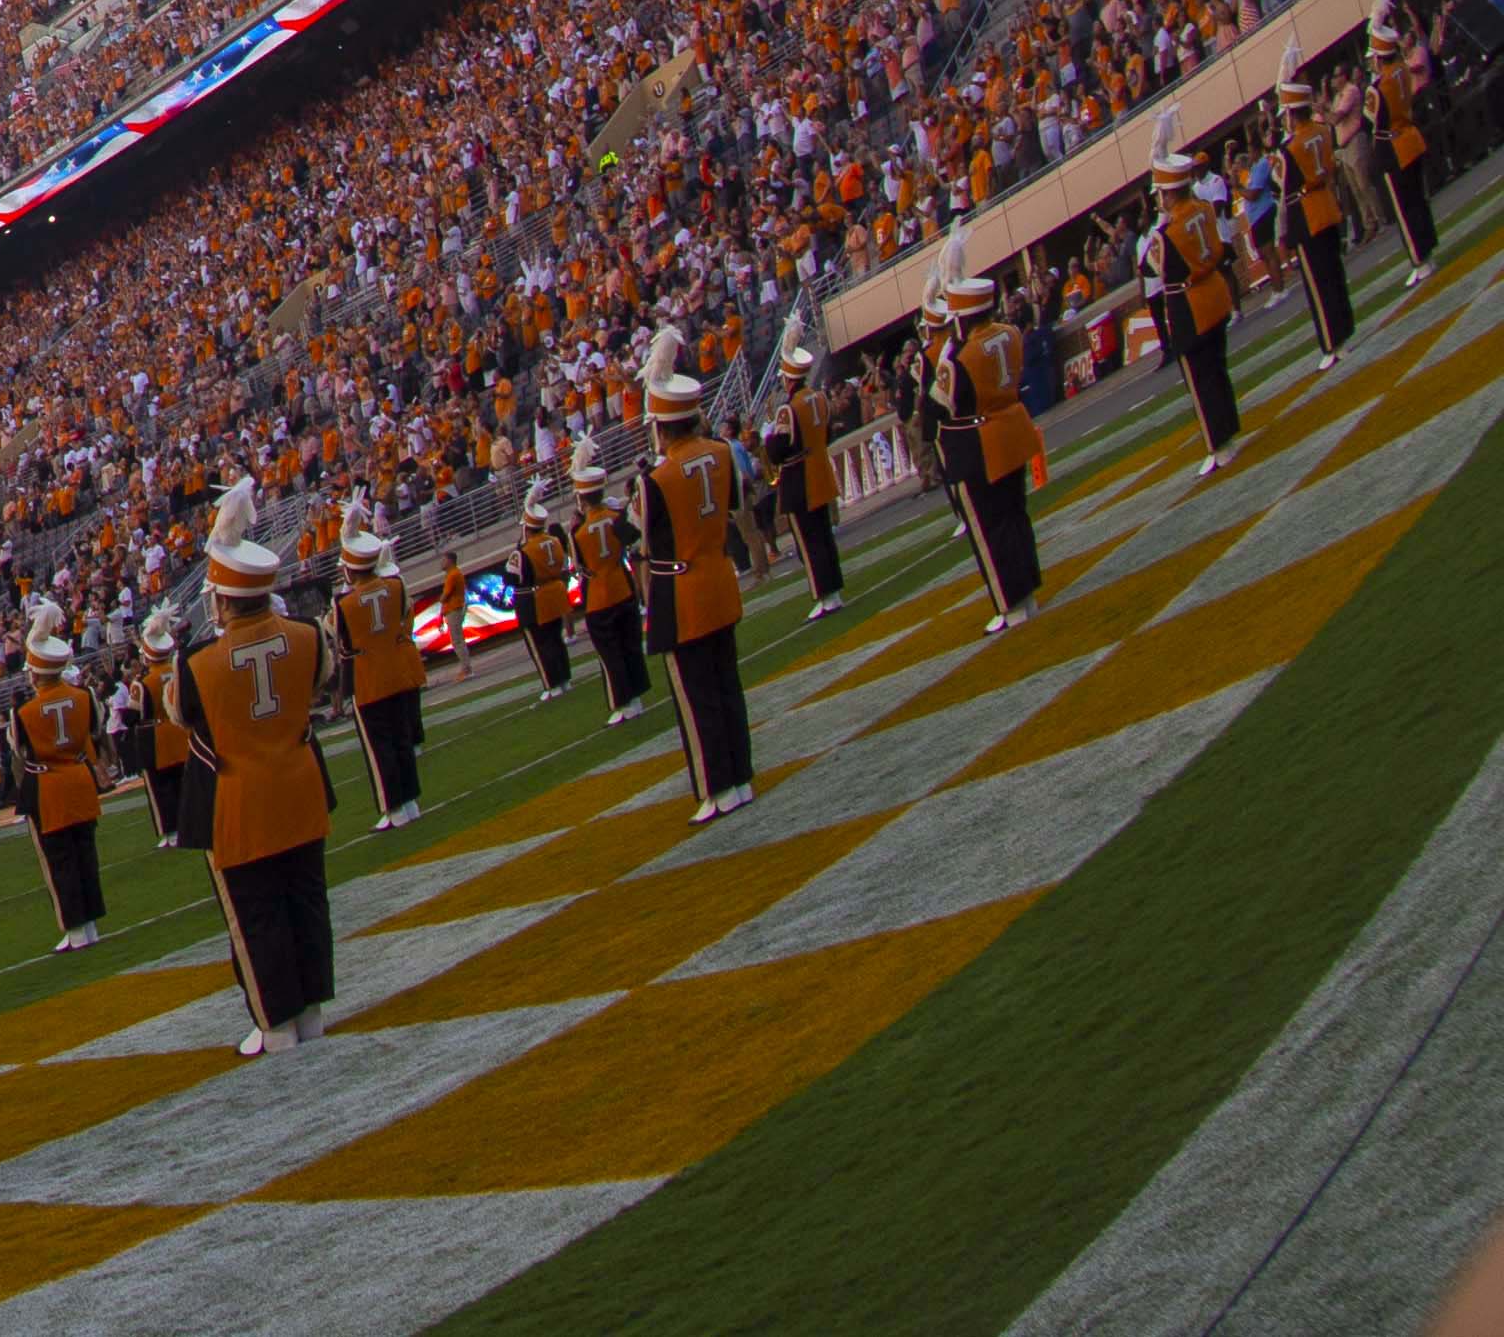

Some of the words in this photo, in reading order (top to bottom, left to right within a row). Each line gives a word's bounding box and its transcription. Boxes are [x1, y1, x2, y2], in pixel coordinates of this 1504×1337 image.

[1303, 134, 1325, 176] T
[1185, 213, 1213, 261] T
[982, 333, 1015, 389] T
[805, 392, 822, 426] T
[681, 452, 721, 519] T
[538, 540, 558, 566] T
[589, 517, 615, 558] T
[358, 589, 389, 632] T
[230, 632, 288, 721] T
[40, 698, 75, 747] T
